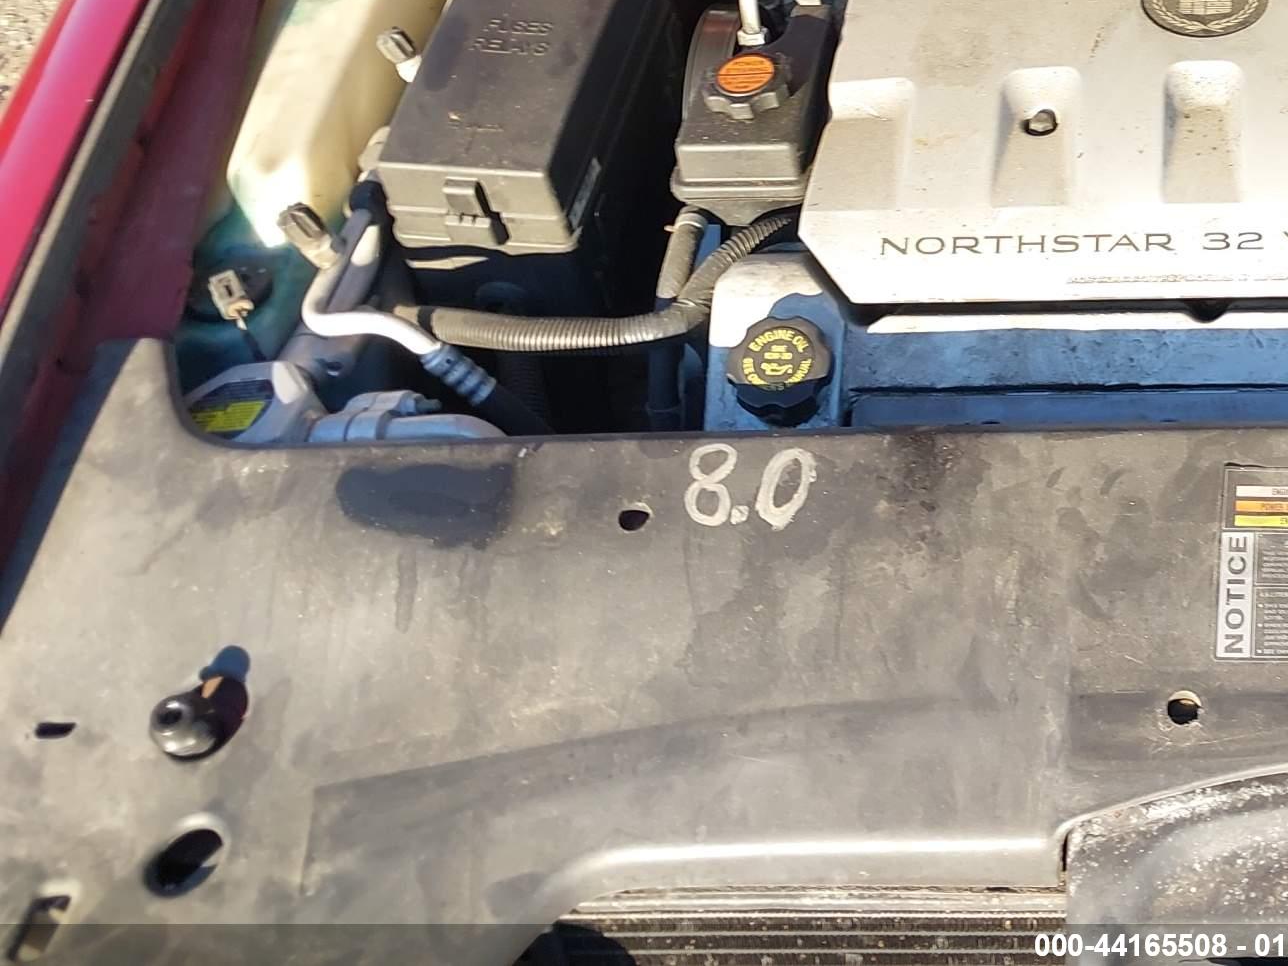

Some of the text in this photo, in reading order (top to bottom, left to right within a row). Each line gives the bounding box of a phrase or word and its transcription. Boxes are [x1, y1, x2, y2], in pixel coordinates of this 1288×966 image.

[879, 233, 1178, 256] NORTHSTAR
[1203, 231, 1264, 251] 32
[748, 329, 809, 353] ENGINE OIL
[684, 443, 818, 530] 8.0
[1224, 537, 1247, 653] NOTICE
